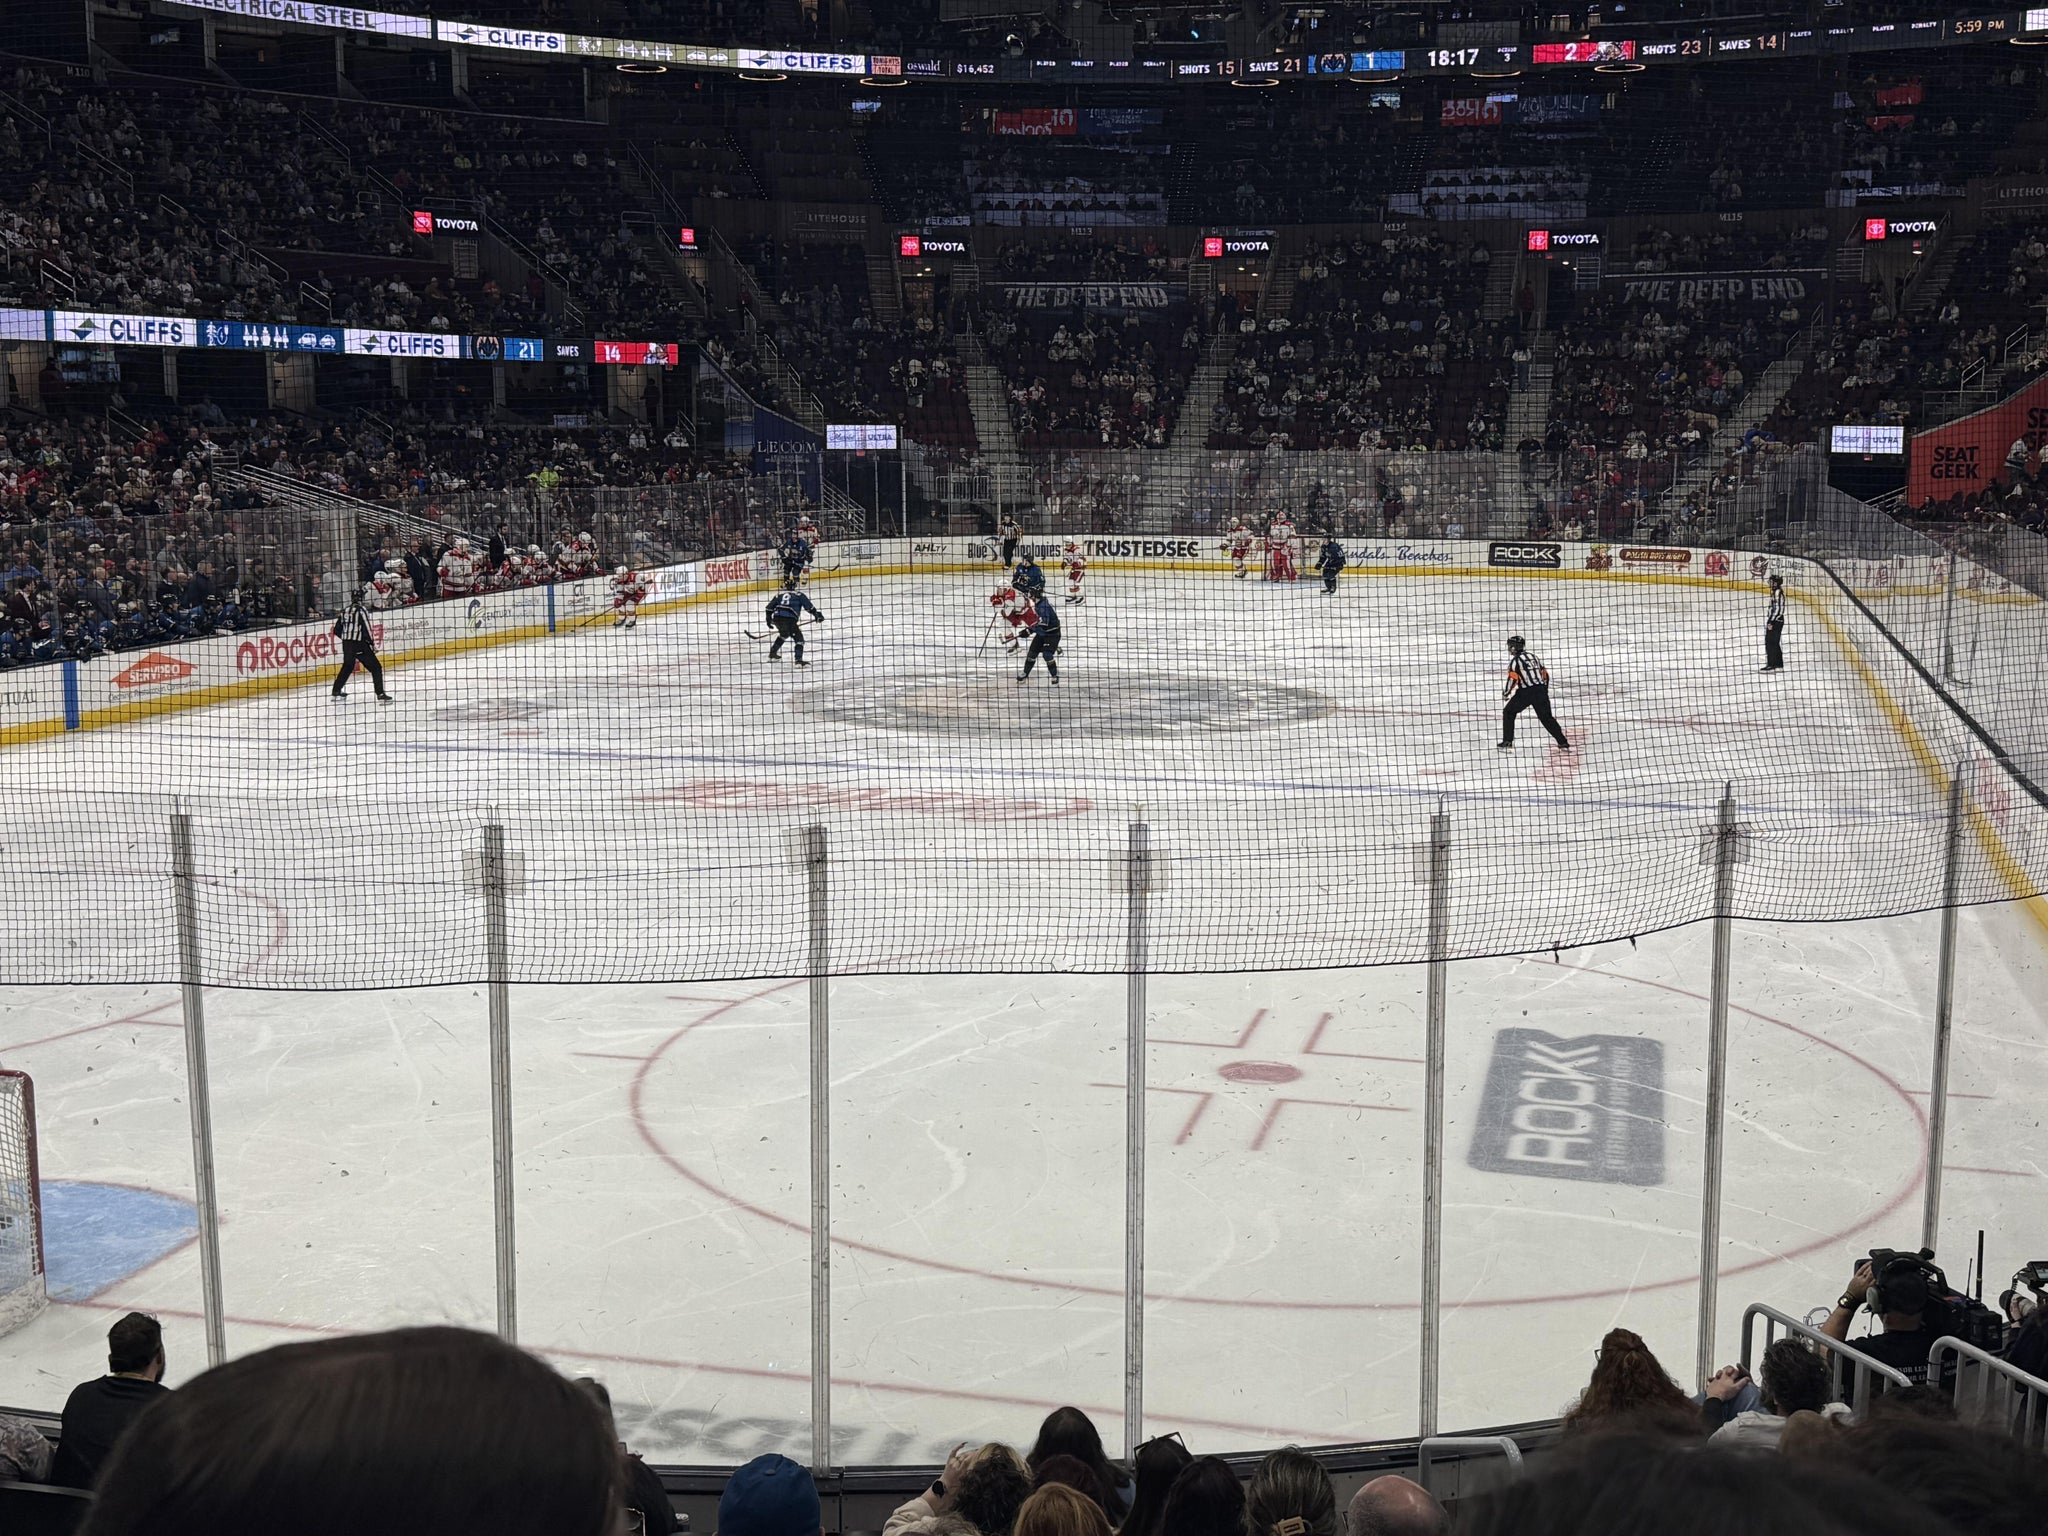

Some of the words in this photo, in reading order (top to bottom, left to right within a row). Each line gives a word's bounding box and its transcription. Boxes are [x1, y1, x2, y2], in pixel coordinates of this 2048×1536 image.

[193, 0, 308, 20] ECTRICAL
[314, 8, 376, 28] STEEL
[1954, 19, 1983, 34] 5:59
[1987, 19, 2005, 30] PM
[488, 30, 559, 49] CLIFFS
[1642, 44, 1676, 55] SHOTS
[1681, 40, 1702, 55] 23
[1718, 39, 1751, 51] SAVES
[1757, 35, 1777, 50] 14
[1427, 48, 1480, 67] 18:17
[1504, 53, 1511, 62] 3
[1564, 43, 1578, 61] 2
[784, 54, 853, 70] CLIFFS
[907, 59, 941, 72] oswald
[956, 63, 995, 74] $16,452
[1178, 64, 1211, 75] SHOTS
[1216, 61, 1236, 76] 15
[1249, 61, 1279, 73] SAVES
[1283, 58, 1301, 73] 21
[1366, 53, 1375, 69] 1
[435, 218, 479, 231] TOYOTA
[1888, 220, 1936, 233] TOYOTA
[922, 241, 966, 252] TOYOTA
[1225, 240, 1270, 252] TOYOTA
[1552, 233, 1600, 245] TOYOTA
[1003, 287, 1049, 308] THE
[1117, 286, 1169, 308] END
[1623, 280, 1675, 304] THE
[1751, 277, 1806, 301] END
[109, 319, 183, 343] CLIFFS
[388, 335, 444, 355] CLIFFS
[519, 341, 535, 358] 21
[556, 345, 580, 358] SAVES
[604, 344, 621, 361] 14
[1934, 445, 1980, 462] SEAT
[1931, 463, 1980, 479] GEEK
[967, 543, 987, 558] Blue
[1083, 540, 1198, 557] TRUSTEDSEC
[1494, 546, 1556, 560] ROCK
[705, 556, 751, 587] SEATGEEK
[259, 625, 339, 671] Rocket
[129, 664, 180, 682] SERVPRO
[1504, 1041, 1600, 1166] ROCK
